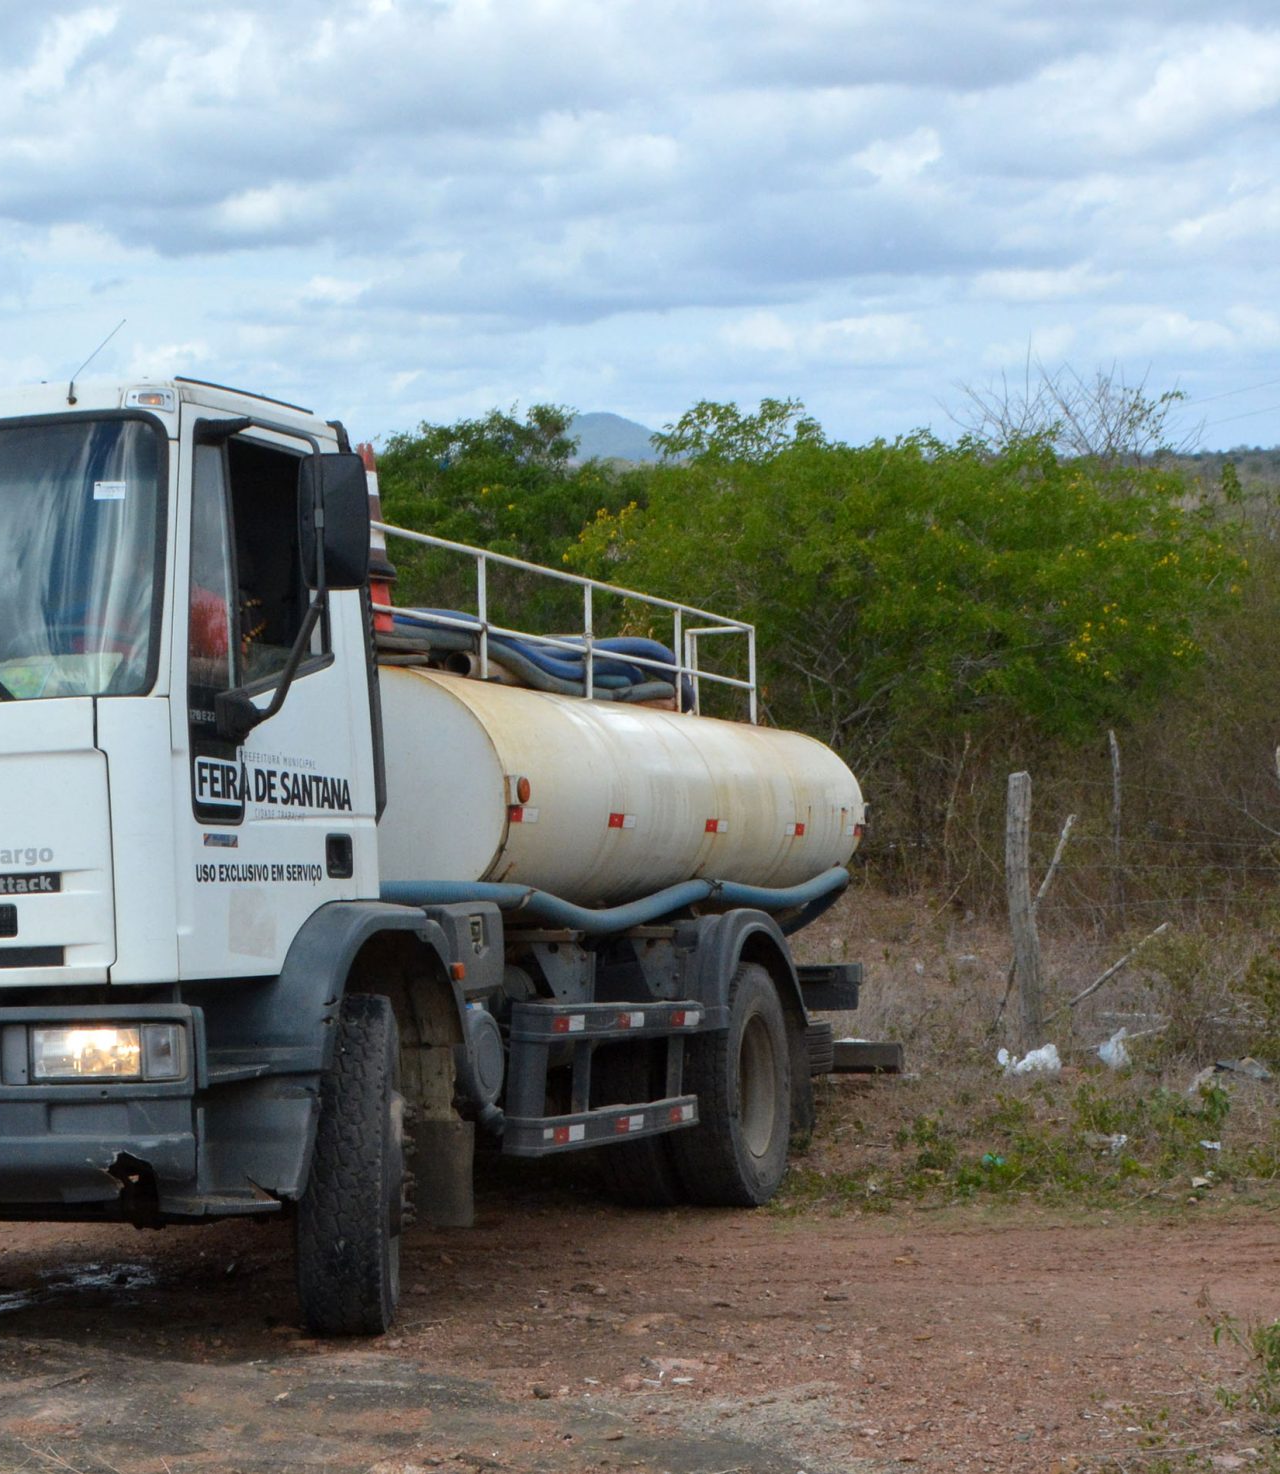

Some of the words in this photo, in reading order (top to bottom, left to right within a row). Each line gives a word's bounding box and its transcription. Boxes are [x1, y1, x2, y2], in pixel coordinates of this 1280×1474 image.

[238, 750, 280, 765] PREFEITURA
[283, 756, 316, 769] MUNICIPAL
[197, 761, 252, 801] FEIRA
[254, 768, 278, 804] DE
[280, 771, 353, 811] SANTANA
[195, 864, 217, 883] USO
[219, 864, 269, 882] EXCLUSIVO
[271, 865, 284, 882] EM
[286, 864, 322, 887] SERVIÇO
